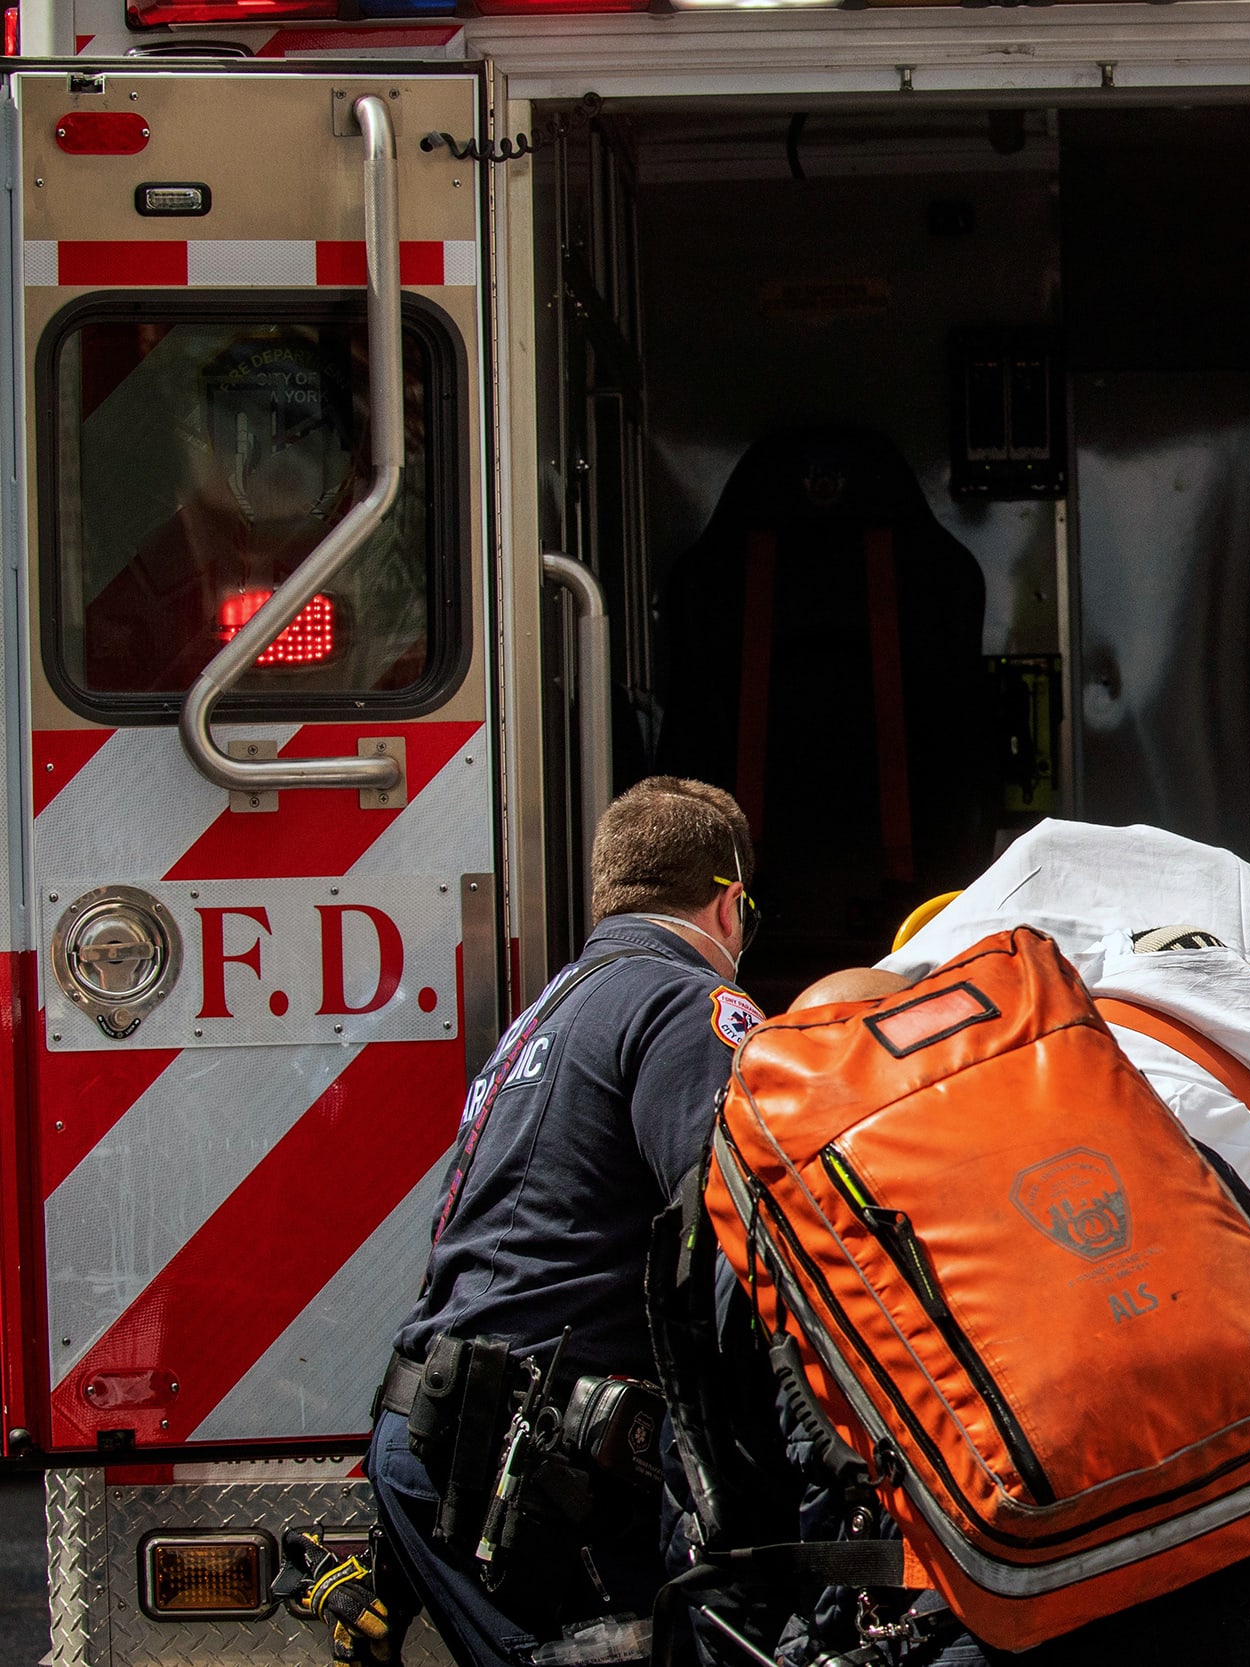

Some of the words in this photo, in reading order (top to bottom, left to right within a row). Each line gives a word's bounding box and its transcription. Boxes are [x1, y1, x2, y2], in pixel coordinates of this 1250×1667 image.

[220, 361, 252, 393] FRE
[252, 348, 345, 390] DEPARTEN
[295, 371, 318, 386] OF
[284, 389, 329, 404] YORK
[194, 904, 438, 1018] F.D.
[721, 1024, 737, 1039] CITY
[1108, 1282, 1160, 1324] ALS
